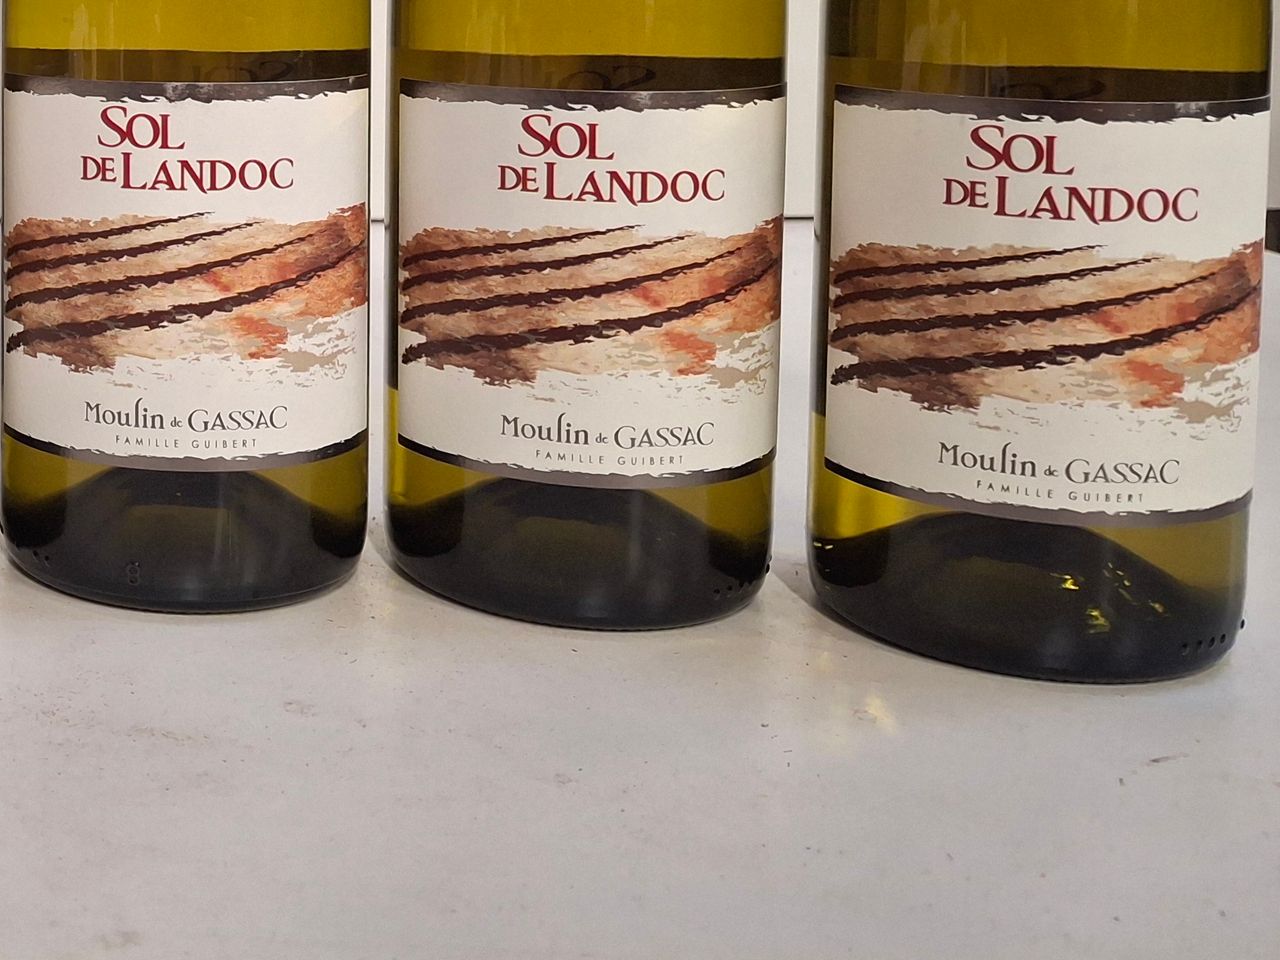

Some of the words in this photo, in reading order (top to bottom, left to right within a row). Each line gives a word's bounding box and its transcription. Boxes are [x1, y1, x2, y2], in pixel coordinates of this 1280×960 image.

[97, 106, 185, 150] SOL
[518, 114, 614, 160] SOL
[966, 124, 1074, 175] SOL
[81, 156, 117, 182] DE
[121, 152, 294, 193] LANDOC
[498, 165, 539, 193] DE
[544, 162, 725, 207] LANDOC
[942, 178, 989, 208] DE
[994, 176, 1199, 225] LANDOC
[84, 397, 165, 430] Moulin
[170, 416, 183, 428] de
[188, 405, 288, 433] GASSAC
[500, 412, 589, 445] Moulin
[595, 432, 608, 444] de
[614, 422, 715, 449] GASSAC
[115, 435, 179, 448] FAMILLE
[191, 439, 257, 449] GUIBERT
[536, 449, 605, 464] FAMILLE
[618, 455, 684, 466] GUIBERT
[938, 442, 1036, 478] Moulin
[1044, 466, 1059, 477] de
[1064, 459, 1180, 485] GASSAC
[976, 480, 1054, 499] FAMILLE
[1069, 491, 1144, 503] GUIBERT
